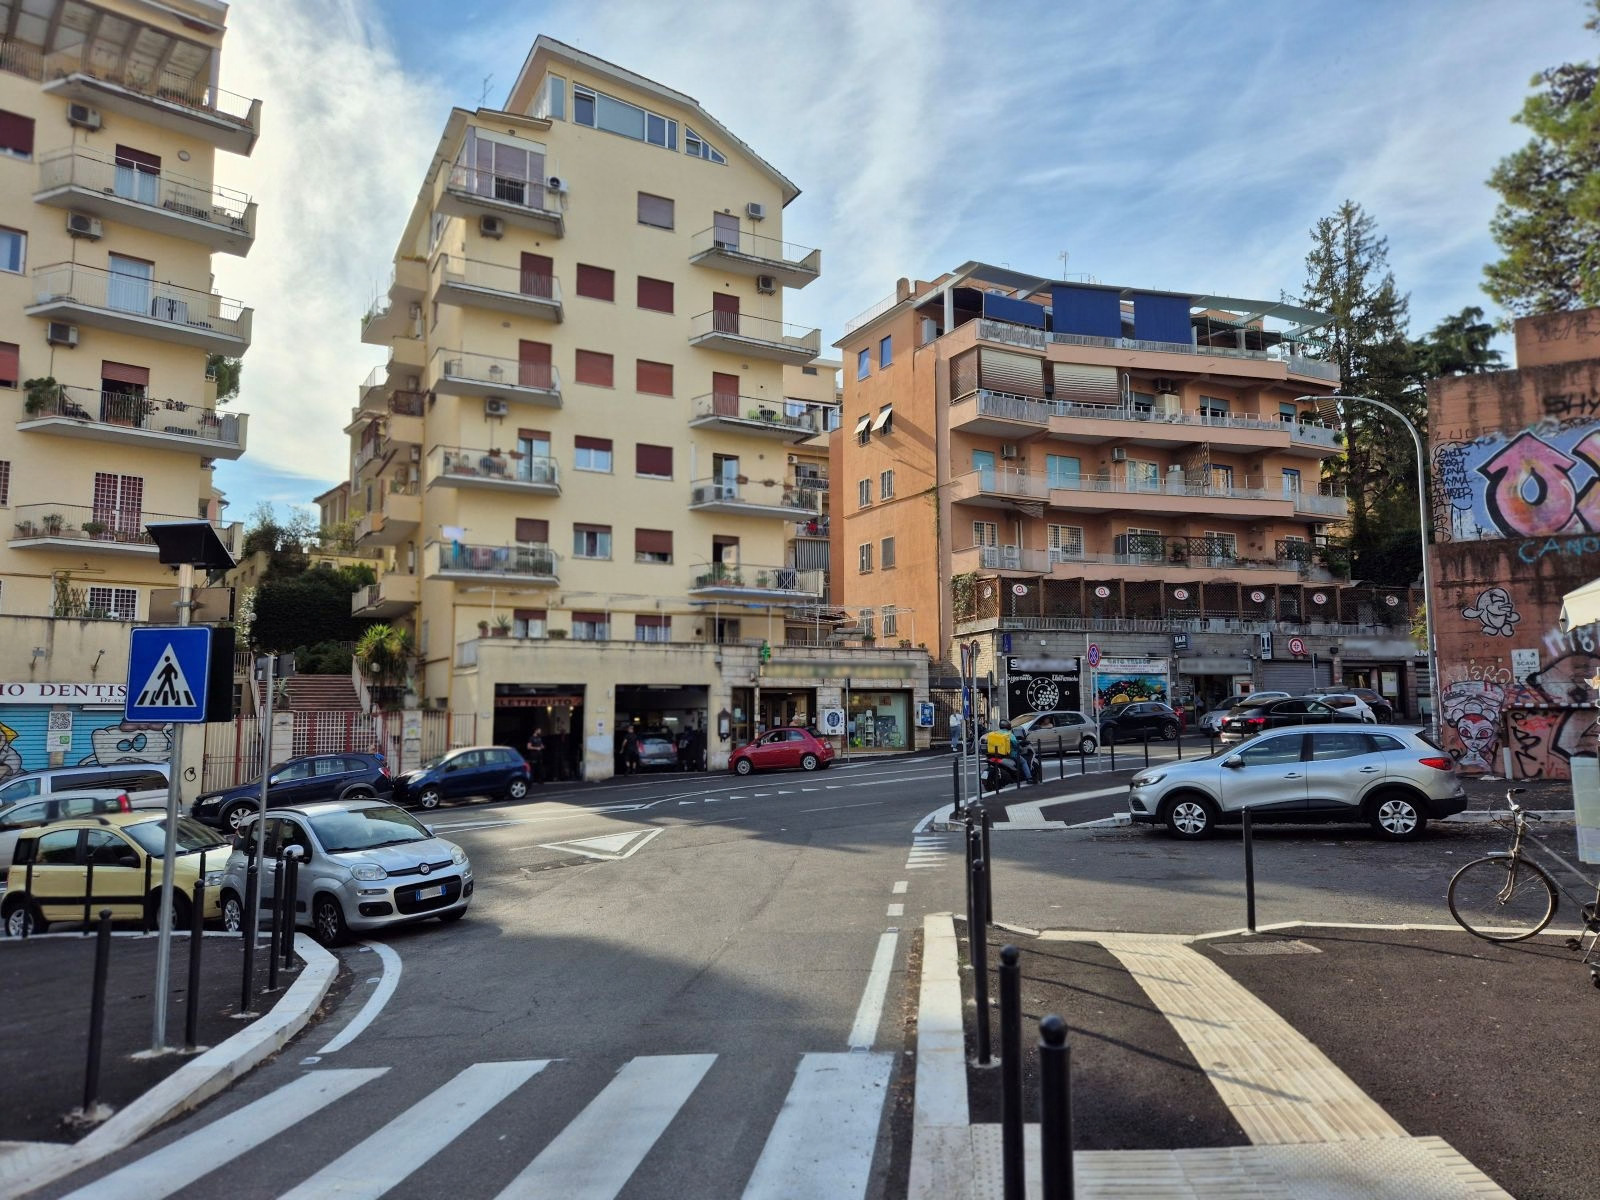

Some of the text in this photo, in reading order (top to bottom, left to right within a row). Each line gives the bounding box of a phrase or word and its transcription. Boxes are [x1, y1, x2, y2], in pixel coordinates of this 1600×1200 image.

[1174, 635, 1186, 643] BAR
[40, 684, 127, 697] DENTIS
[496, 698, 572, 706] LETTRAUTO
